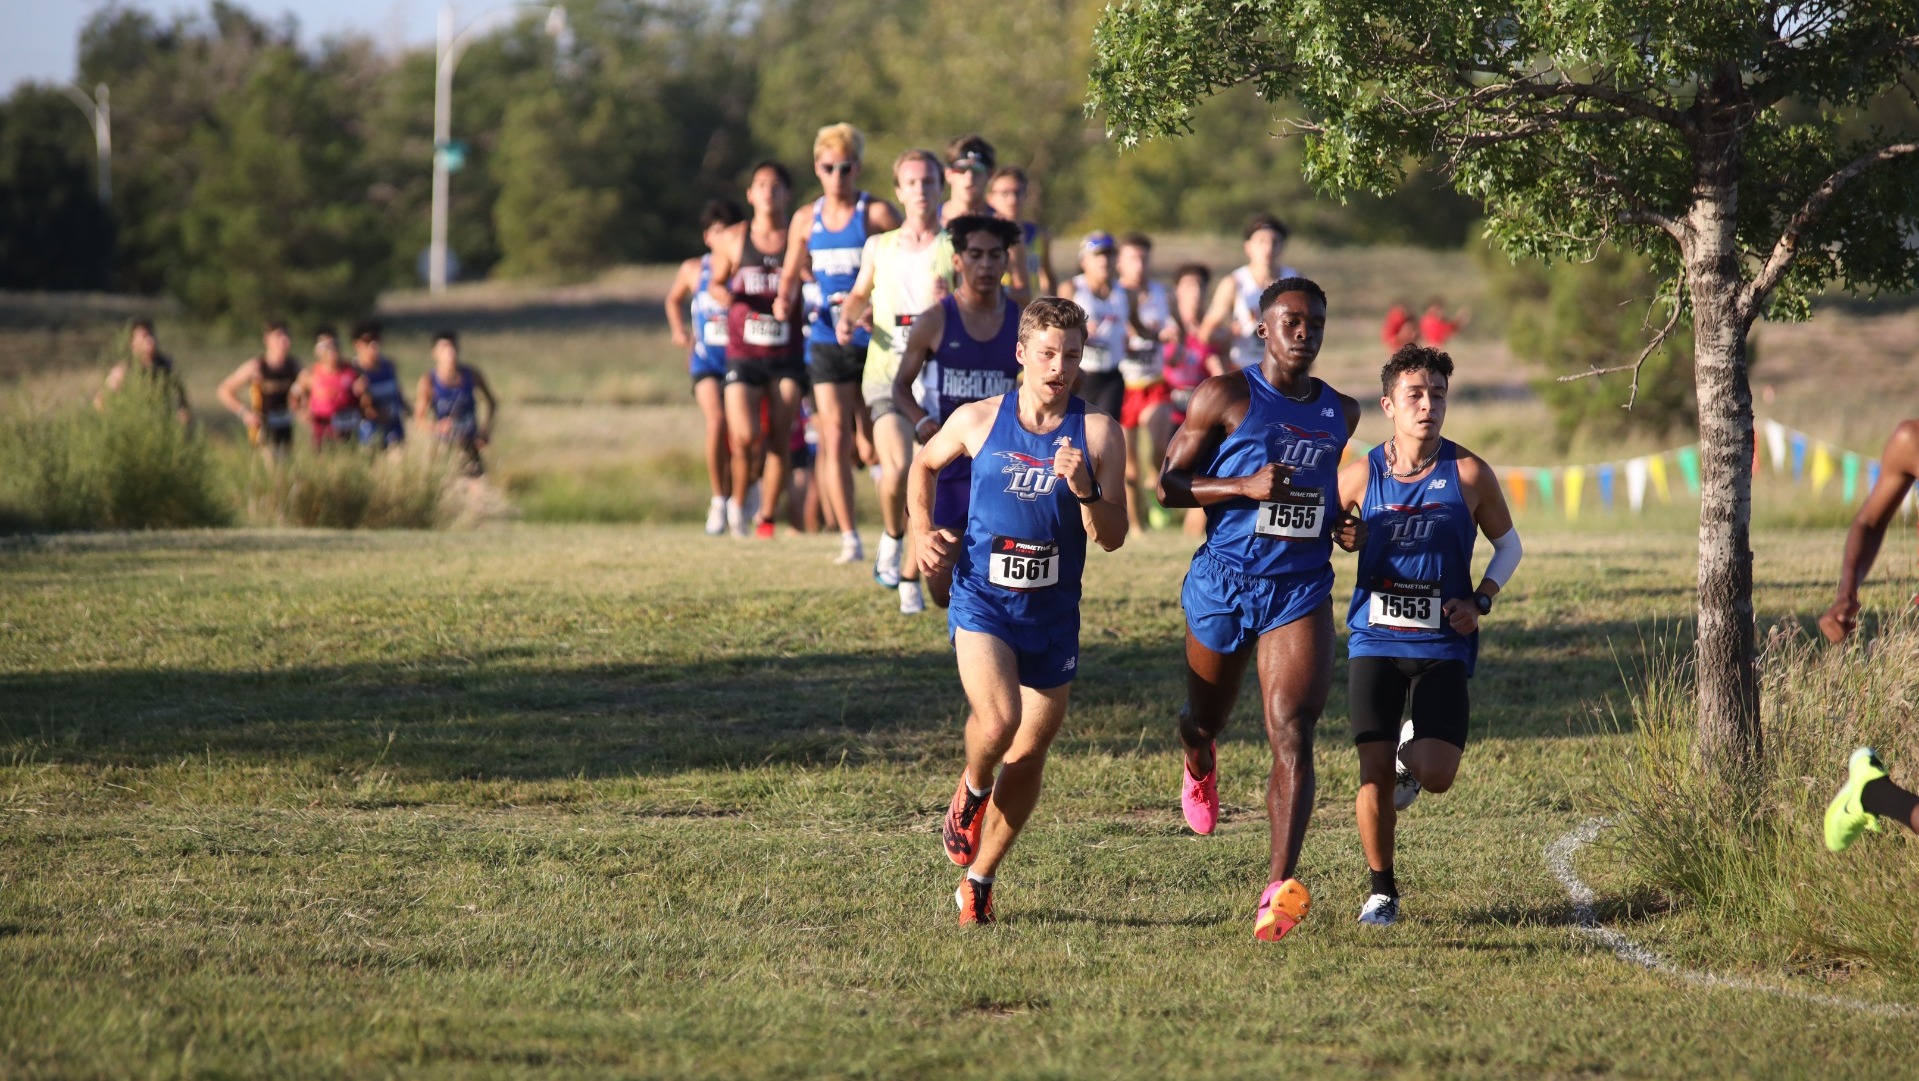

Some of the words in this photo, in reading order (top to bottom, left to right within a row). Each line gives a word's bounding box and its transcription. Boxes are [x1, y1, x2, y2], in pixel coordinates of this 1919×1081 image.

[943, 367, 965, 377] NEW
[969, 369, 1005, 378] MEXICO
[1281, 439, 1323, 474] LCU
[1006, 467, 1059, 499] LCU
[1289, 490, 1319, 498] RIMETIME
[1268, 503, 1317, 529] 1555
[1389, 514, 1435, 548] LCU
[1015, 542, 1052, 552] PRIMETIME
[1001, 556, 1050, 581] 1561
[1393, 582, 1431, 590] PRIMETIME
[1379, 594, 1431, 620] 1553
